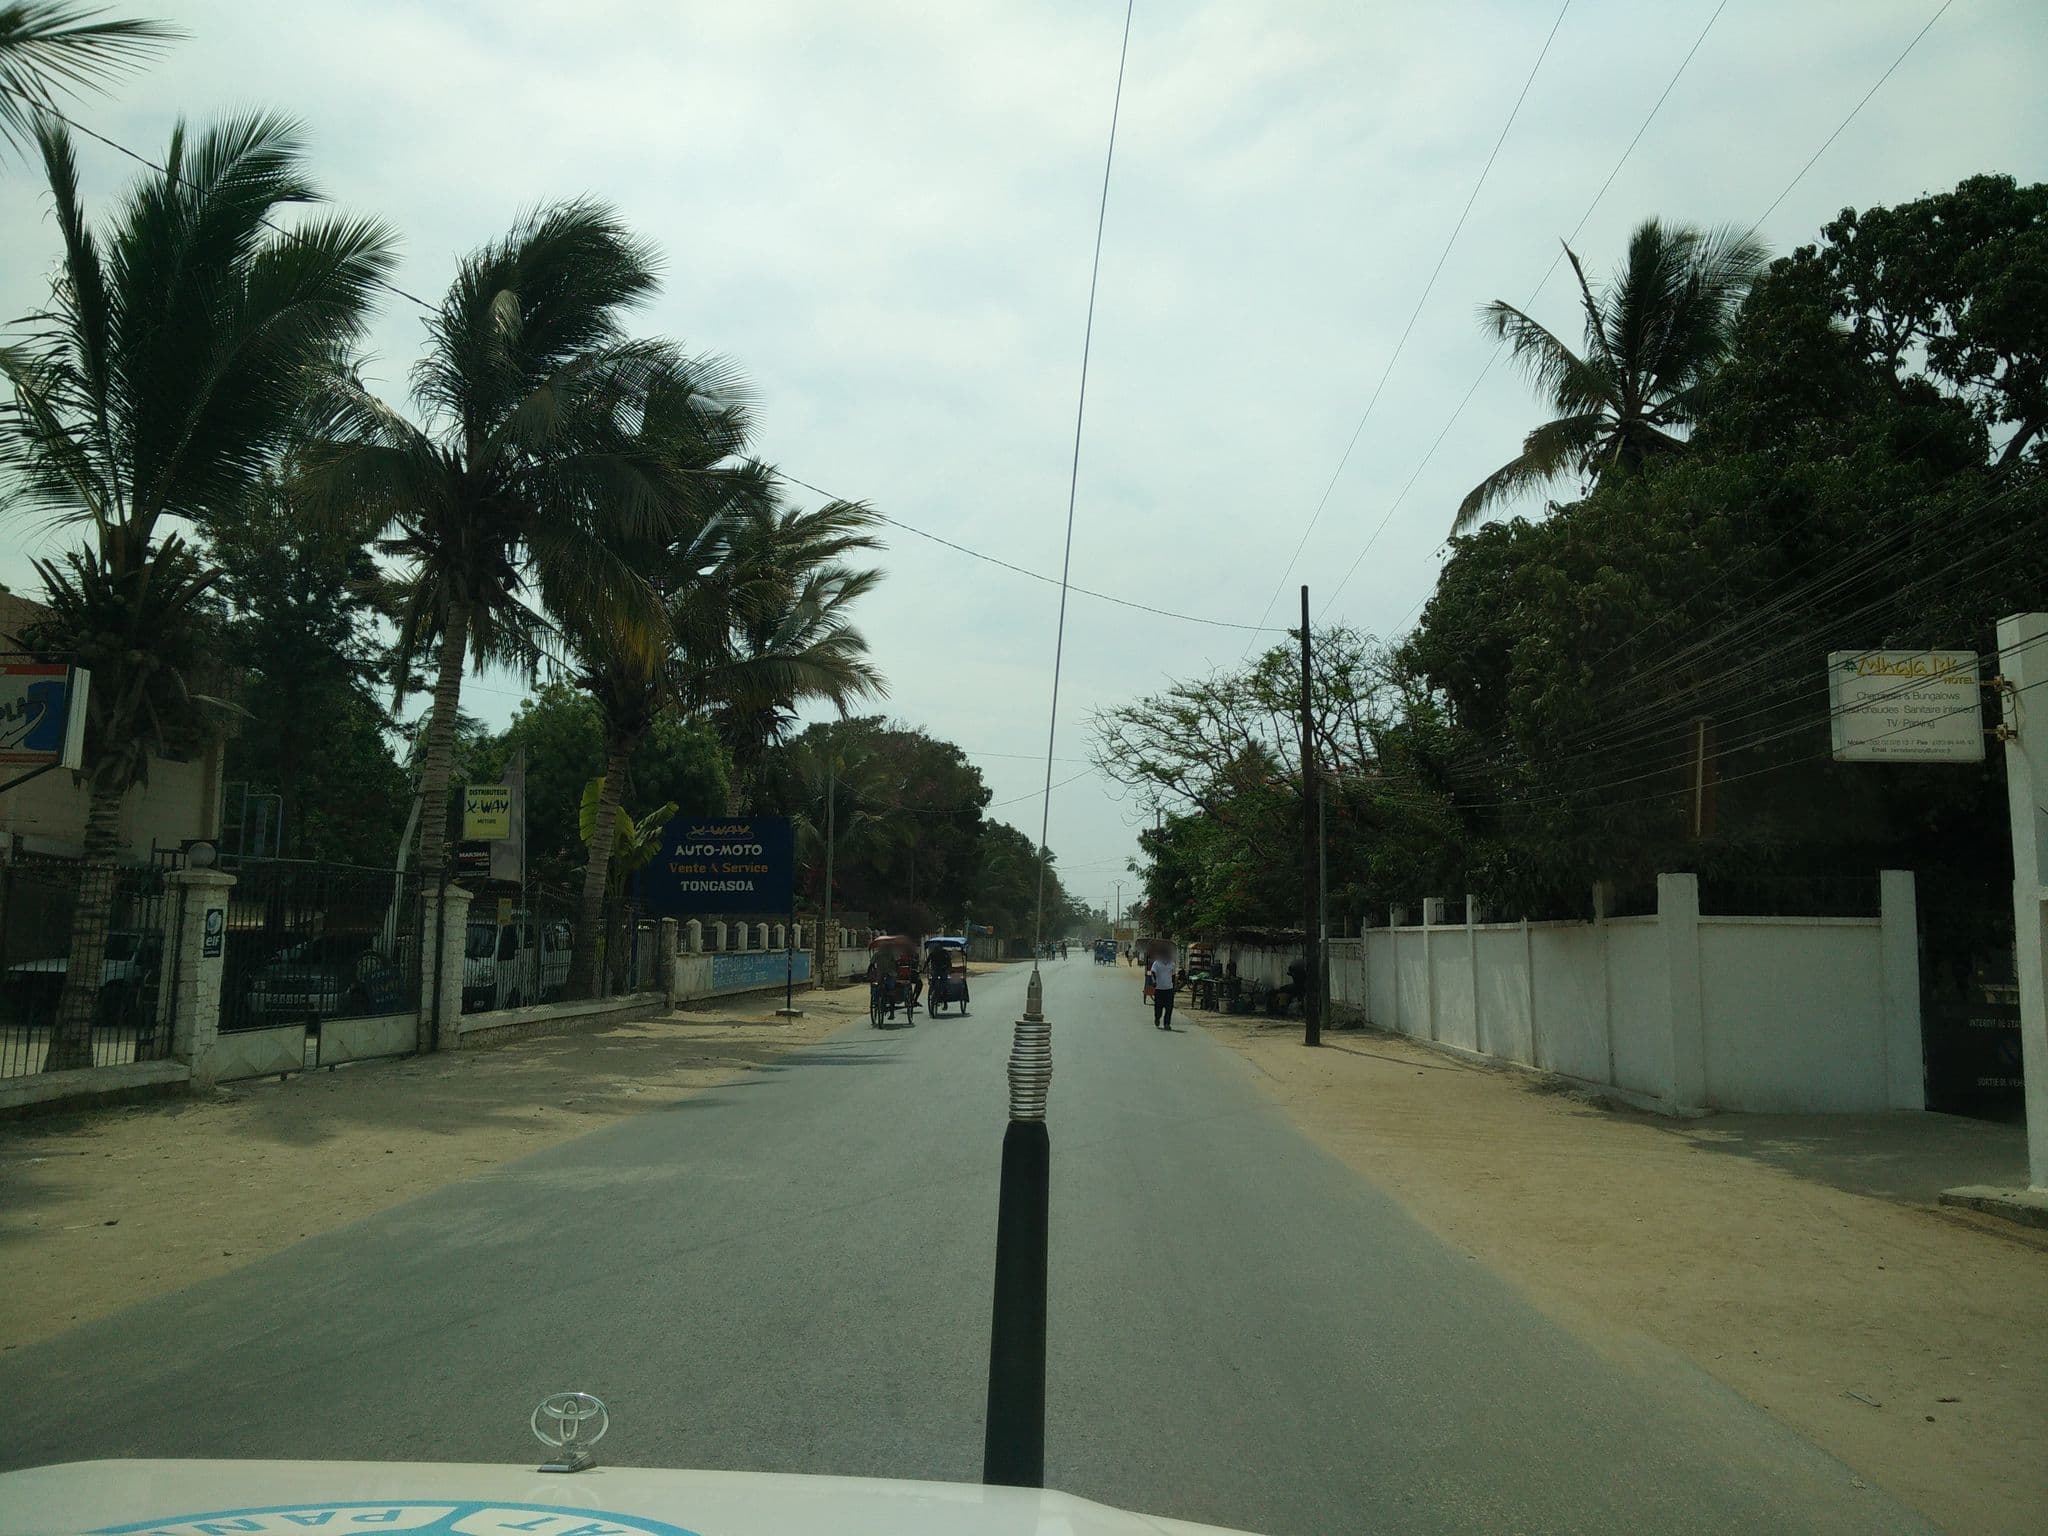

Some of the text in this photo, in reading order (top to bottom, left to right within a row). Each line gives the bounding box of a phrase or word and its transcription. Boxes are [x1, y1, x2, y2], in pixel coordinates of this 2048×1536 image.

[1944, 676, 1975, 685] HOTEL
[1912, 691, 1961, 702] Bungalows
[465, 799, 509, 814] X-WAY
[674, 844, 763, 856] AUTO-MOTO
[669, 862, 707, 873] Vente
[722, 862, 769, 873] Service
[680, 880, 754, 892] TONGASOA
[206, 935, 221, 947] elf
